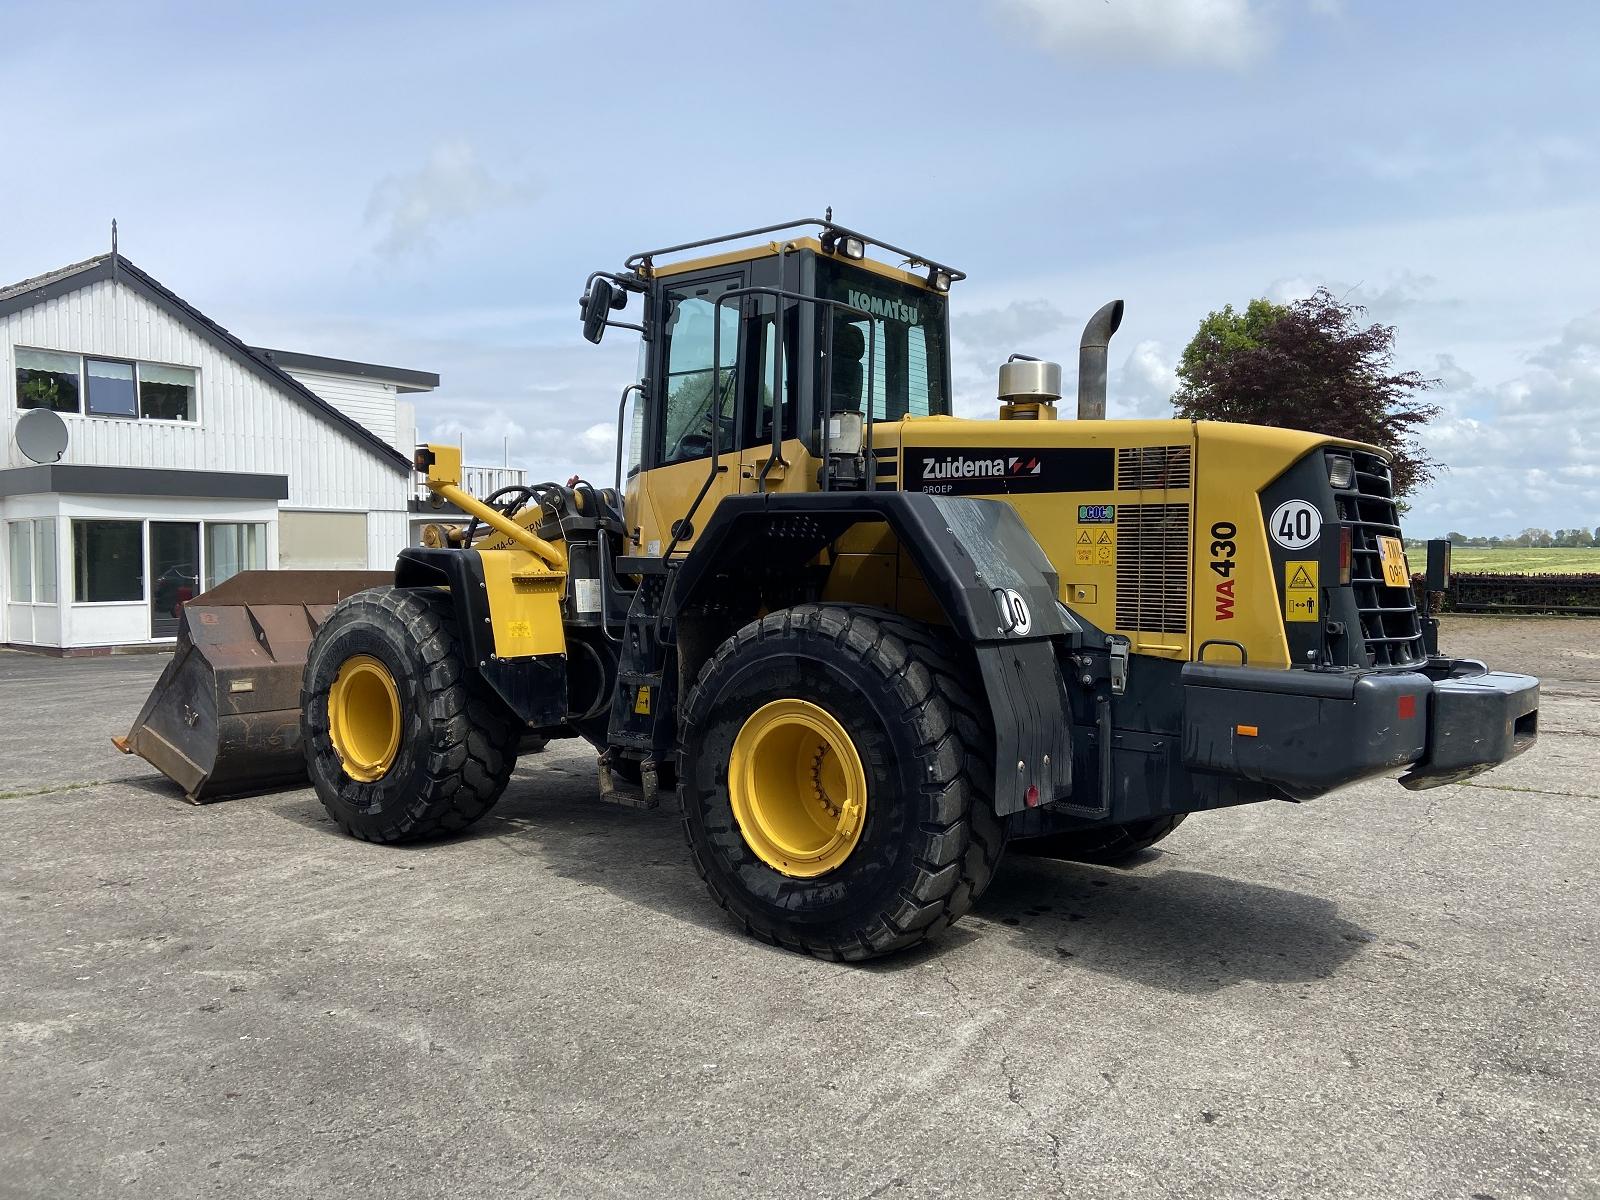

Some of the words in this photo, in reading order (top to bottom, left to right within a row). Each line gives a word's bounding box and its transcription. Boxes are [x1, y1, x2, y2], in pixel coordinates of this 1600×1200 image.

[848, 289, 918, 325] KOMATSU
[922, 456, 1005, 479] Zuidema
[922, 485, 953, 494] GROEP
[1278, 509, 1311, 541] 40
